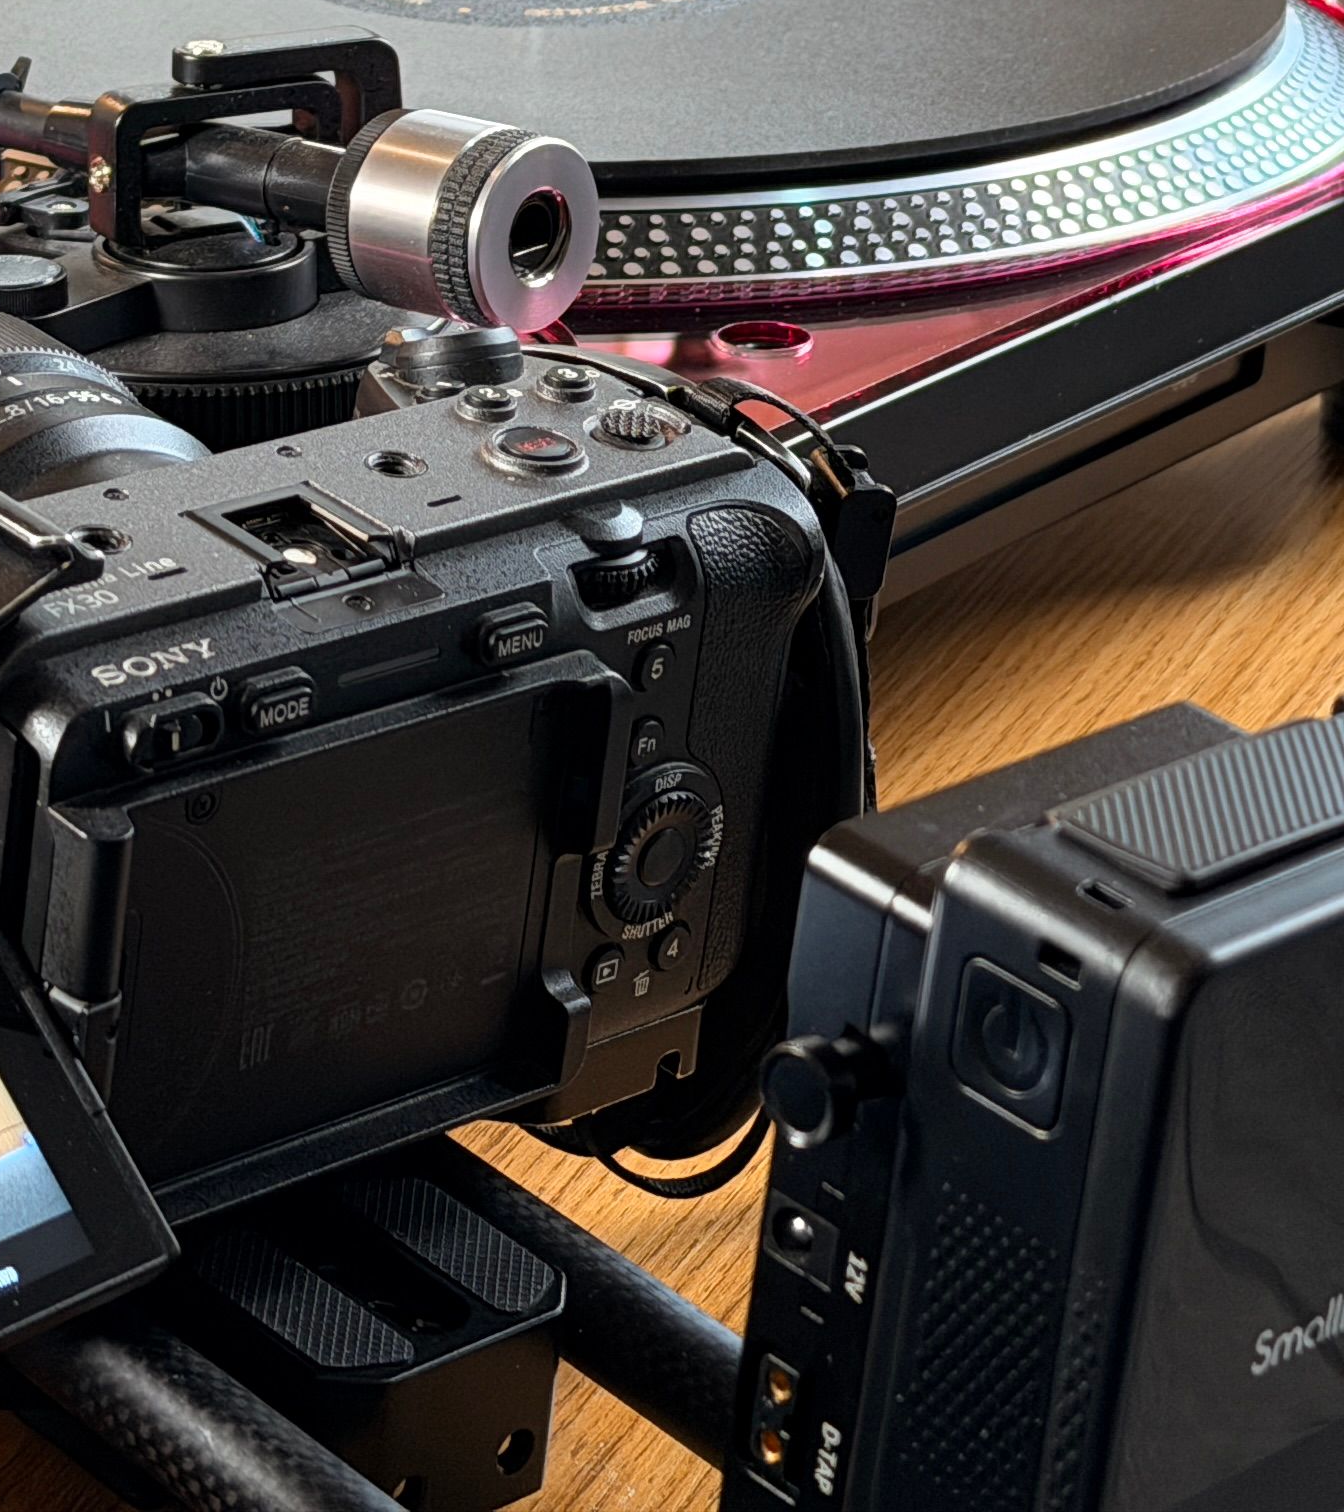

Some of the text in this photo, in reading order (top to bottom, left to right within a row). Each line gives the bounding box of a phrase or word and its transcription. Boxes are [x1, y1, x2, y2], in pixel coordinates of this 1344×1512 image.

[117, 557, 177, 579] Line
[42, 589, 120, 619] FX30
[497, 629, 544, 658] MENU
[627, 614, 691, 645] FOCUS MAG
[90, 637, 216, 688] SONY
[650, 658, 665, 679] 5
[259, 695, 310, 729] MODE
[637, 738, 657, 756] Fn
[655, 773, 682, 793] DISP
[590, 850, 609, 901] ZEBRA
[622, 911, 674, 941] SHUTTER
[667, 938, 679, 958] 4
[844, 1250, 869, 1304] 12V
[814, 1421, 842, 1497] D-TAP
